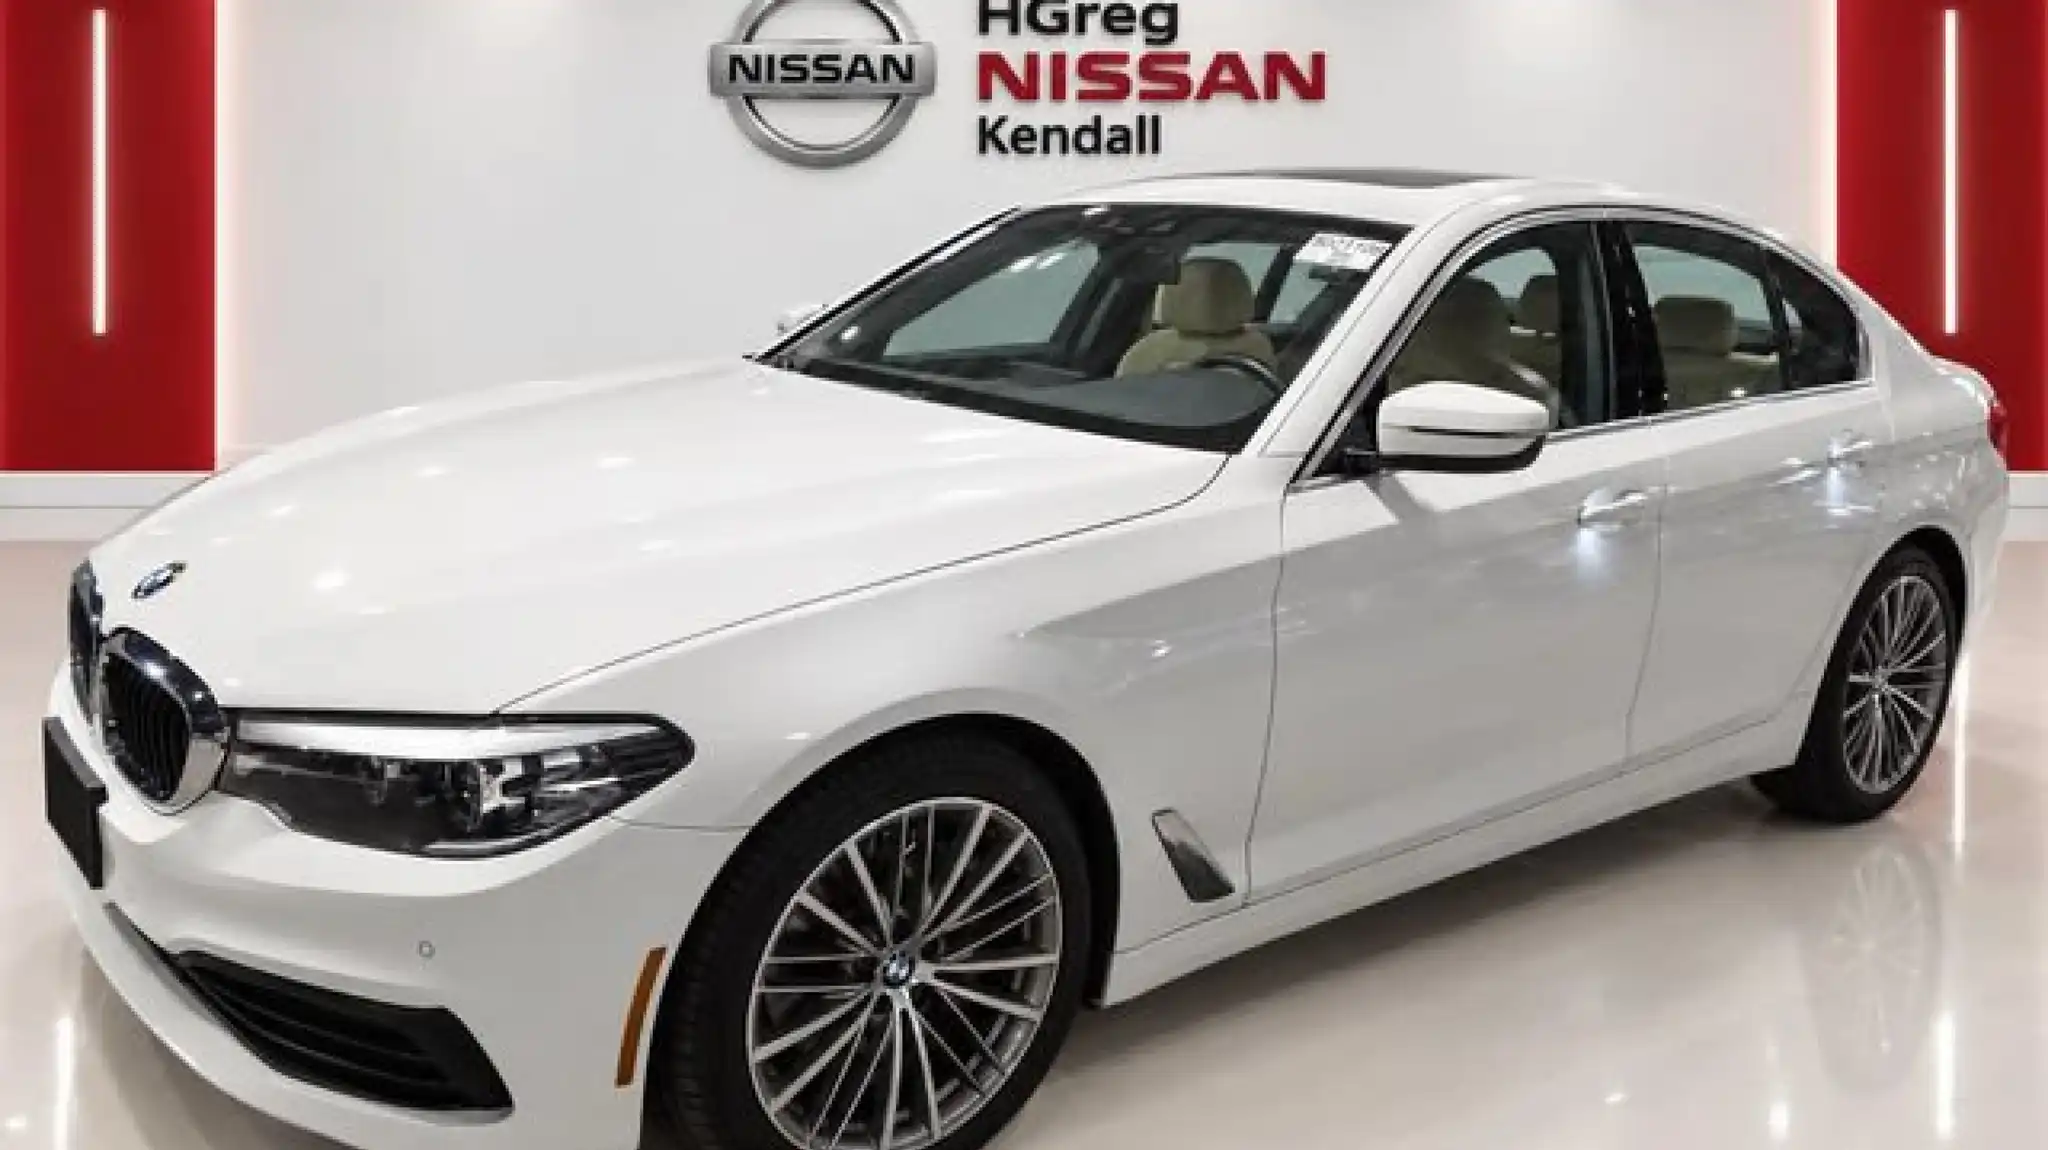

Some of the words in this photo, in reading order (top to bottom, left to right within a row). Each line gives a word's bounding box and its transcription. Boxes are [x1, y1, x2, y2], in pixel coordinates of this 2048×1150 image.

[978, 0, 1179, 46] HGreg
[728, 53, 915, 84] NISSAN
[977, 51, 1326, 102] NISSAN
[977, 114, 1161, 155] Kendall
